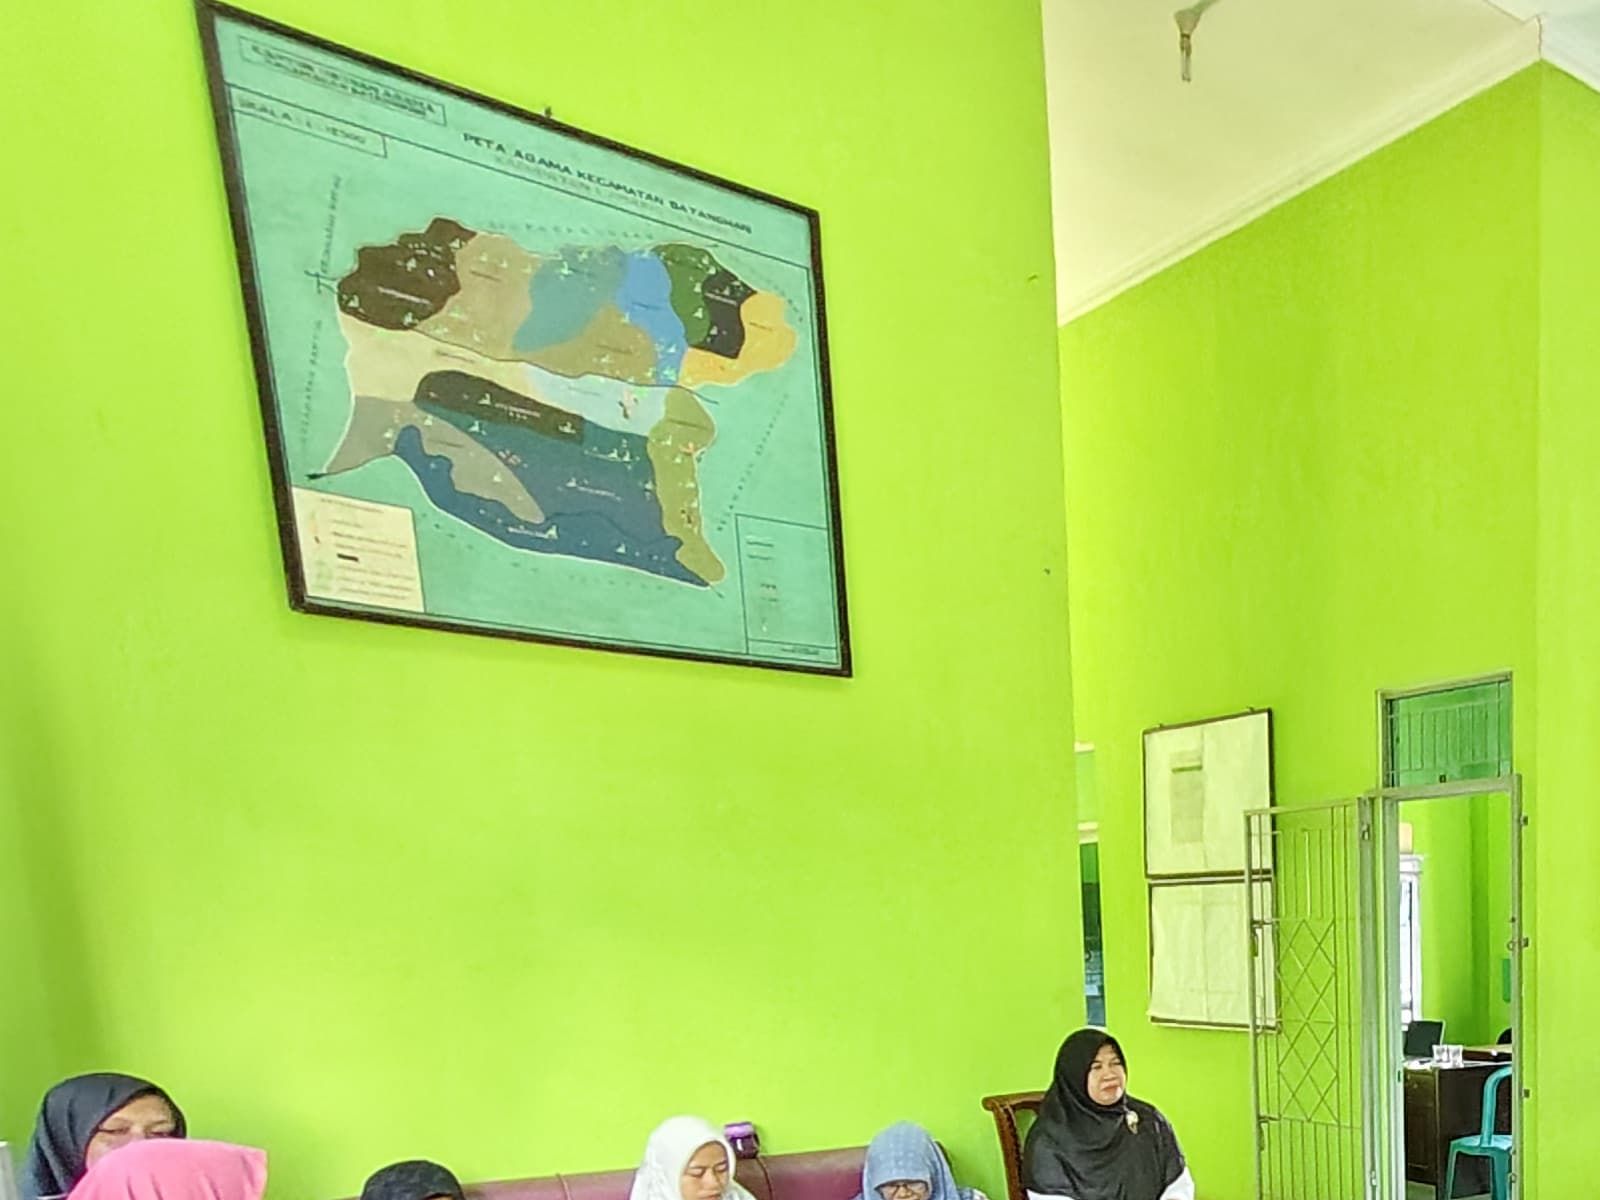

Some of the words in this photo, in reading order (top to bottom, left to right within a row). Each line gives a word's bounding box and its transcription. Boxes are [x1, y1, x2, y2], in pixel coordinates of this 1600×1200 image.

[463, 132, 506, 152] PETA
[513, 149, 573, 175] AGAMA
[576, 169, 664, 205] KECAMATAN
